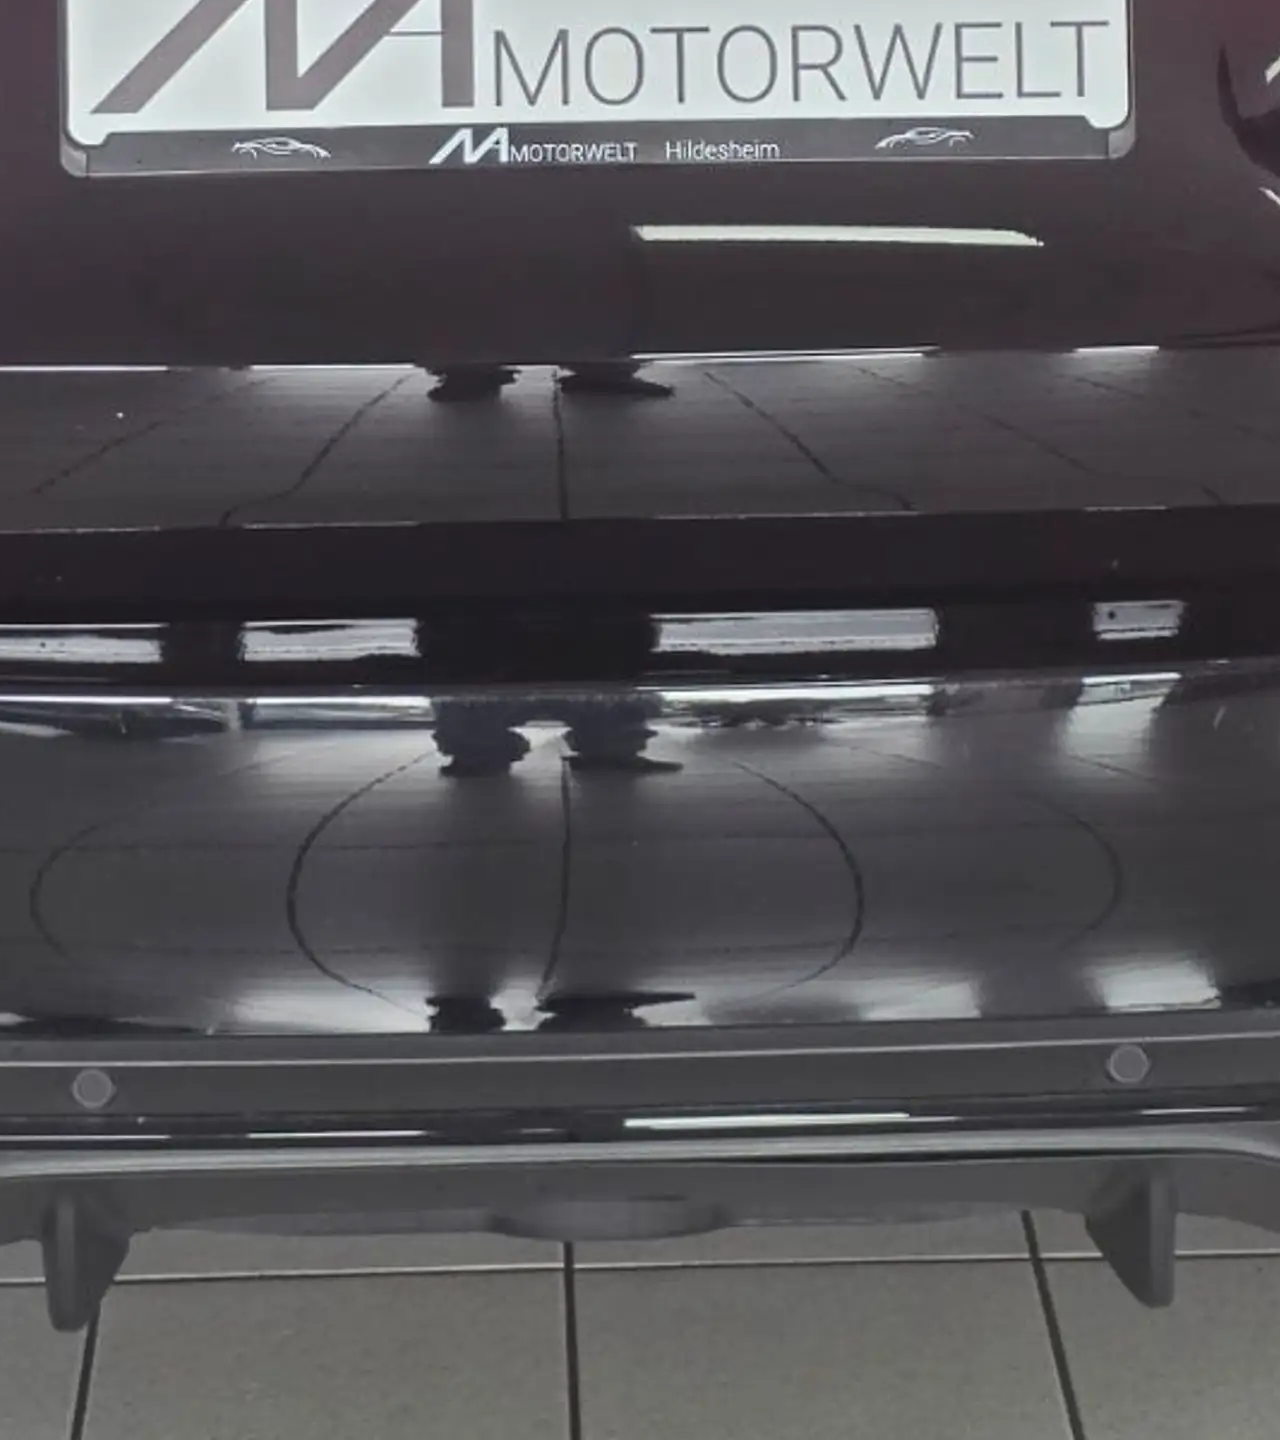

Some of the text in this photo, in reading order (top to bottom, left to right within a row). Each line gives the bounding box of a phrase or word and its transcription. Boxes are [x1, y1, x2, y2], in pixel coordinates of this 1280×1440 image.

[493, 20, 1110, 108] MOTORWELT
[509, 141, 638, 163] MOTORWELT
[665, 140, 781, 161] Hildesheim
